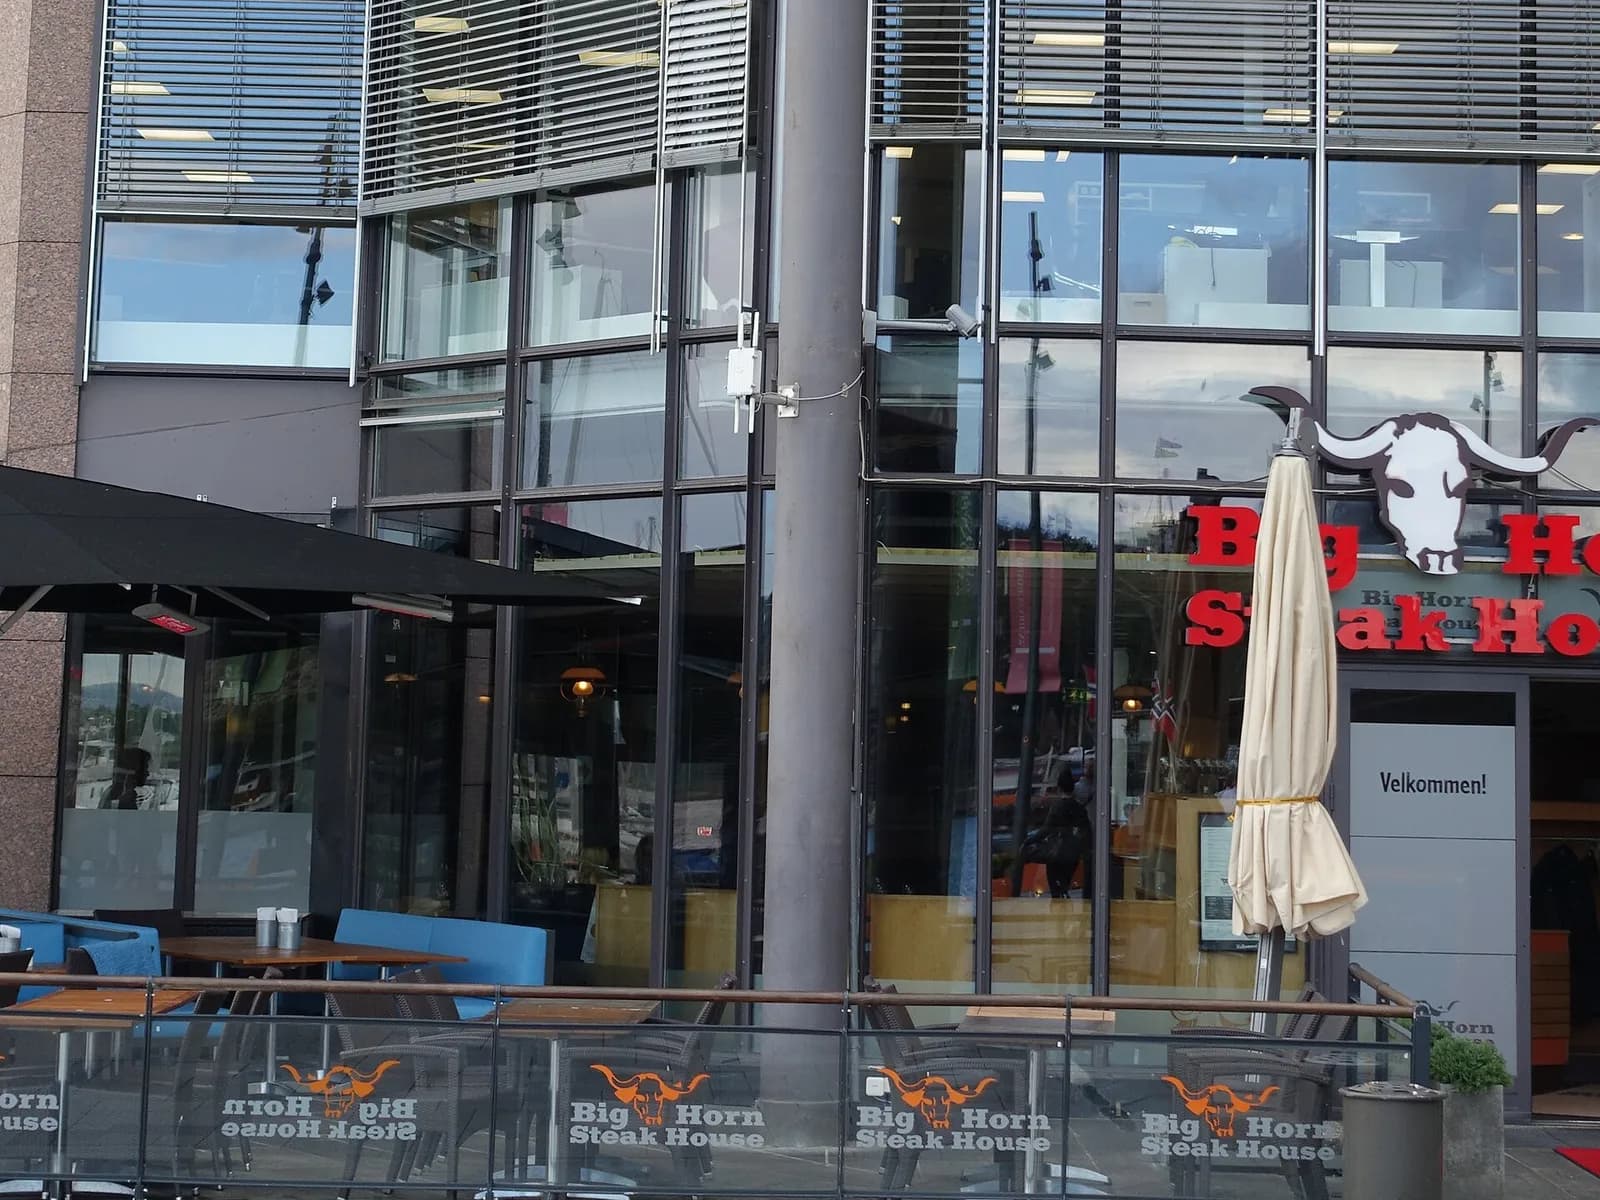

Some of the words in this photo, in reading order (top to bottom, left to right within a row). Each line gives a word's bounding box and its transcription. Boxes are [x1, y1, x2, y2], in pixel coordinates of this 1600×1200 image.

[1186, 505, 1360, 592] Bg
[1186, 589, 1451, 653] Sak
[1379, 771, 1487, 795] Velkommen!
[569, 1102, 628, 1129] Big
[675, 1104, 765, 1127] Horn
[856, 1106, 914, 1133] Big
[961, 1108, 1051, 1130] Horn
[1141, 1113, 1201, 1139] Big
[1246, 1117, 1337, 1139] Horn
[569, 1126, 657, 1146] Steak
[665, 1127, 765, 1148] House
[856, 1130, 943, 1150] Steak
[952, 1131, 1051, 1152] House
[1141, 1137, 1229, 1157] Steak
[1236, 1139, 1336, 1161] House
